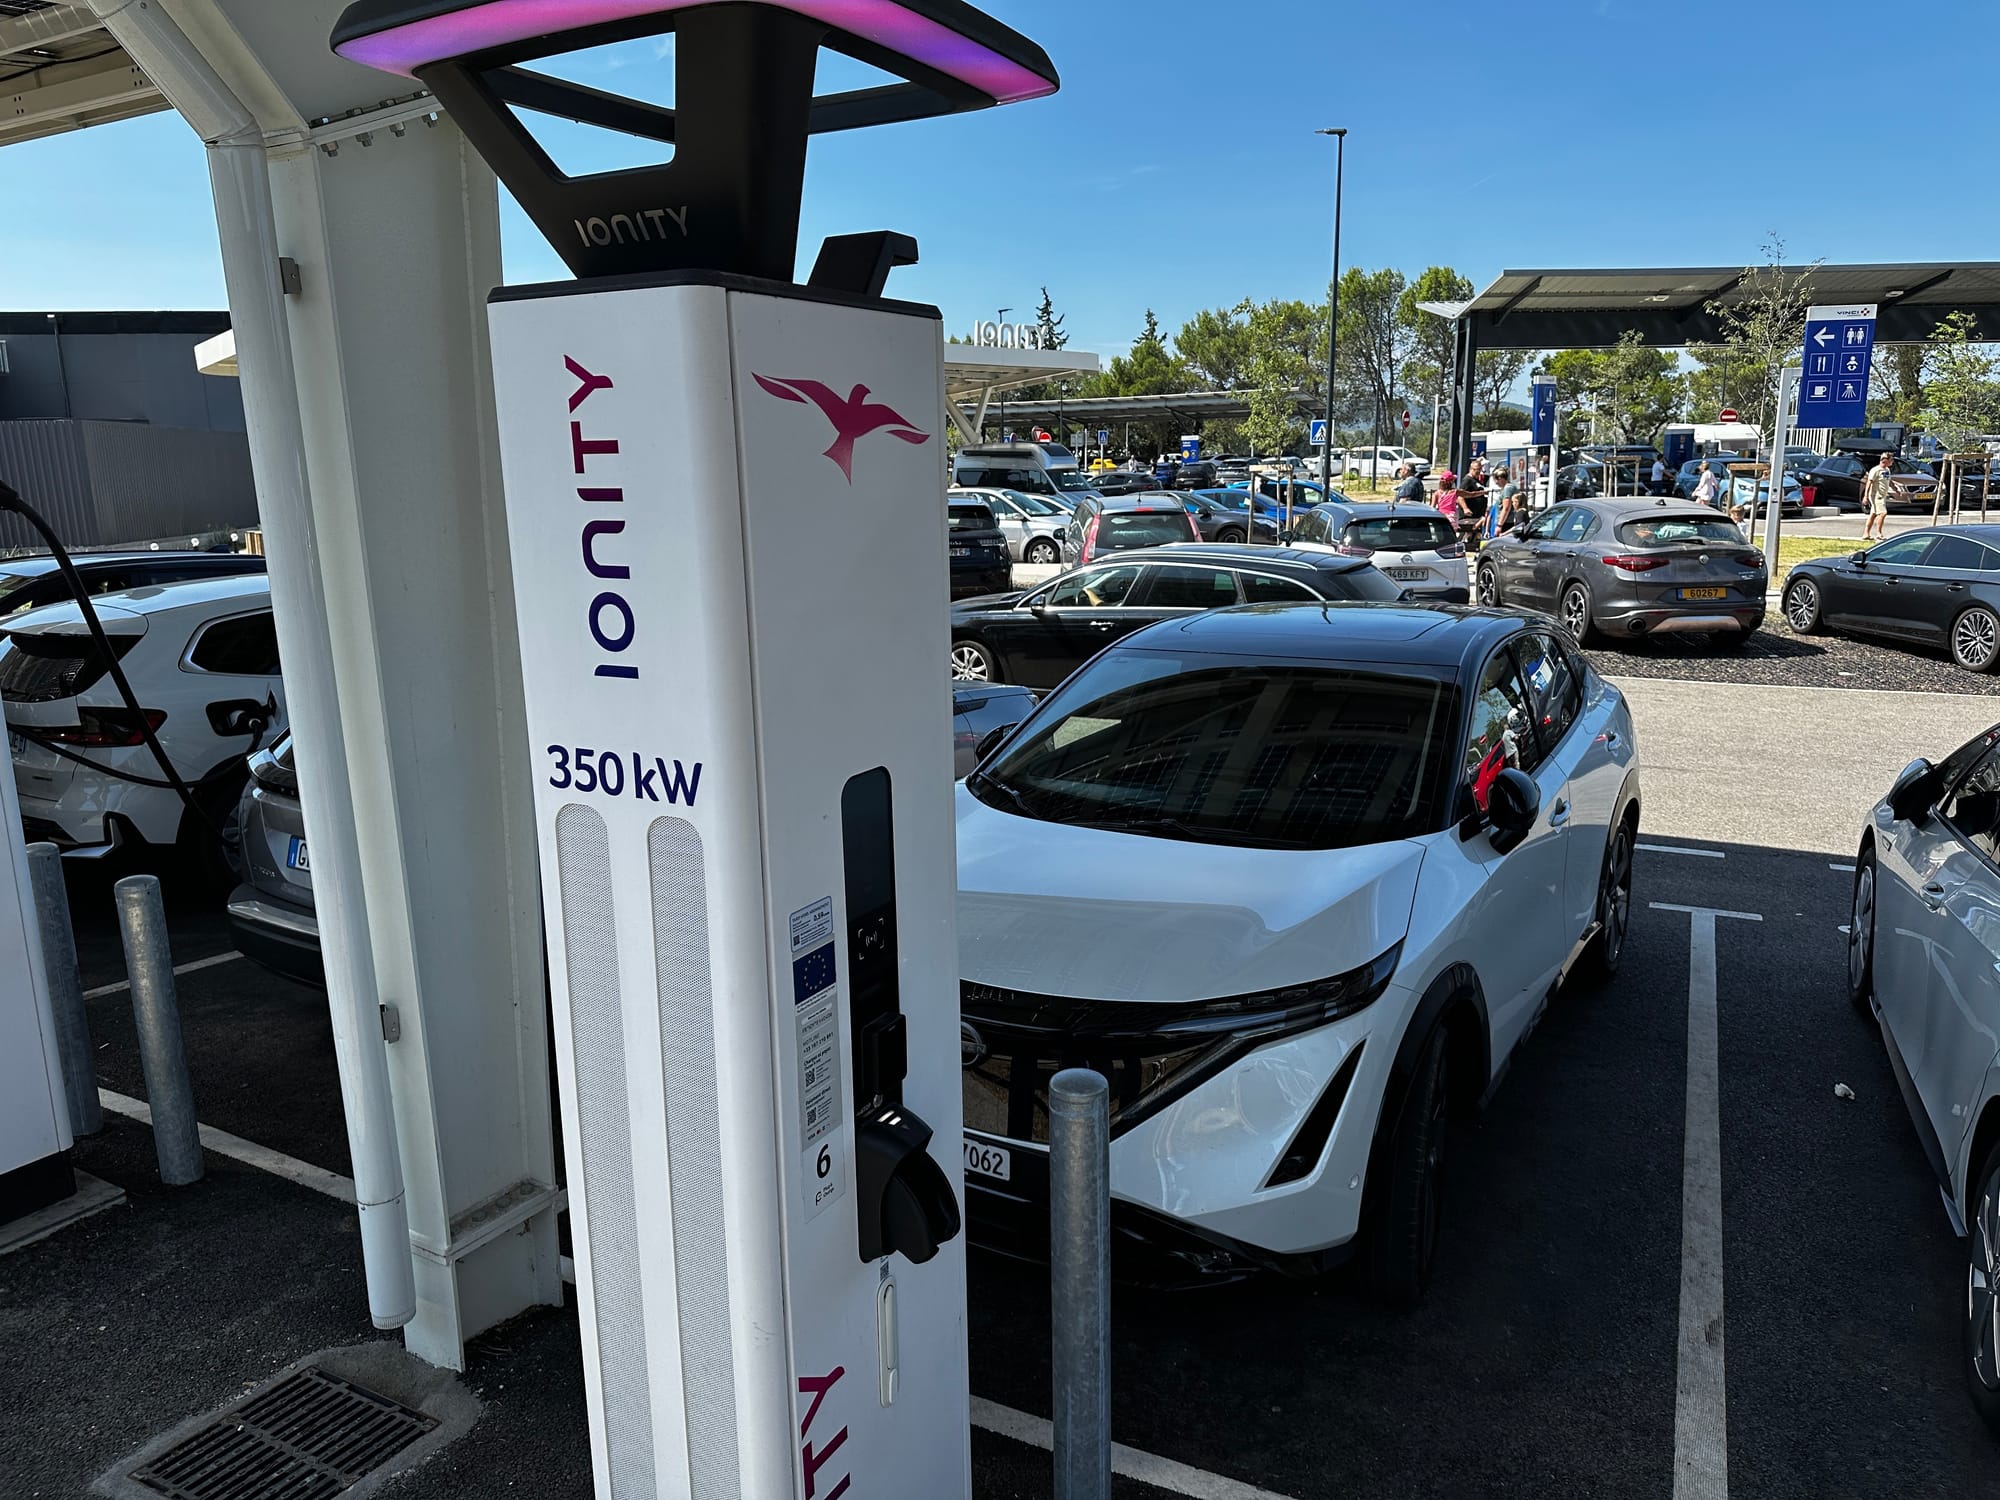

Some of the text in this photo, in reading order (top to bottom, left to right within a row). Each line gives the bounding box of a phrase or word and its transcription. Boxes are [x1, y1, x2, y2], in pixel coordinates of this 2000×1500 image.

[574, 206, 687, 247] IONITY
[974, 320, 1047, 348] IONITY
[564, 354, 639, 679] IONITY
[1690, 588, 1718, 597] 60267
[547, 744, 703, 807] 350 kW
[298, 843, 309, 867] G
[817, 1144, 831, 1178] 6
